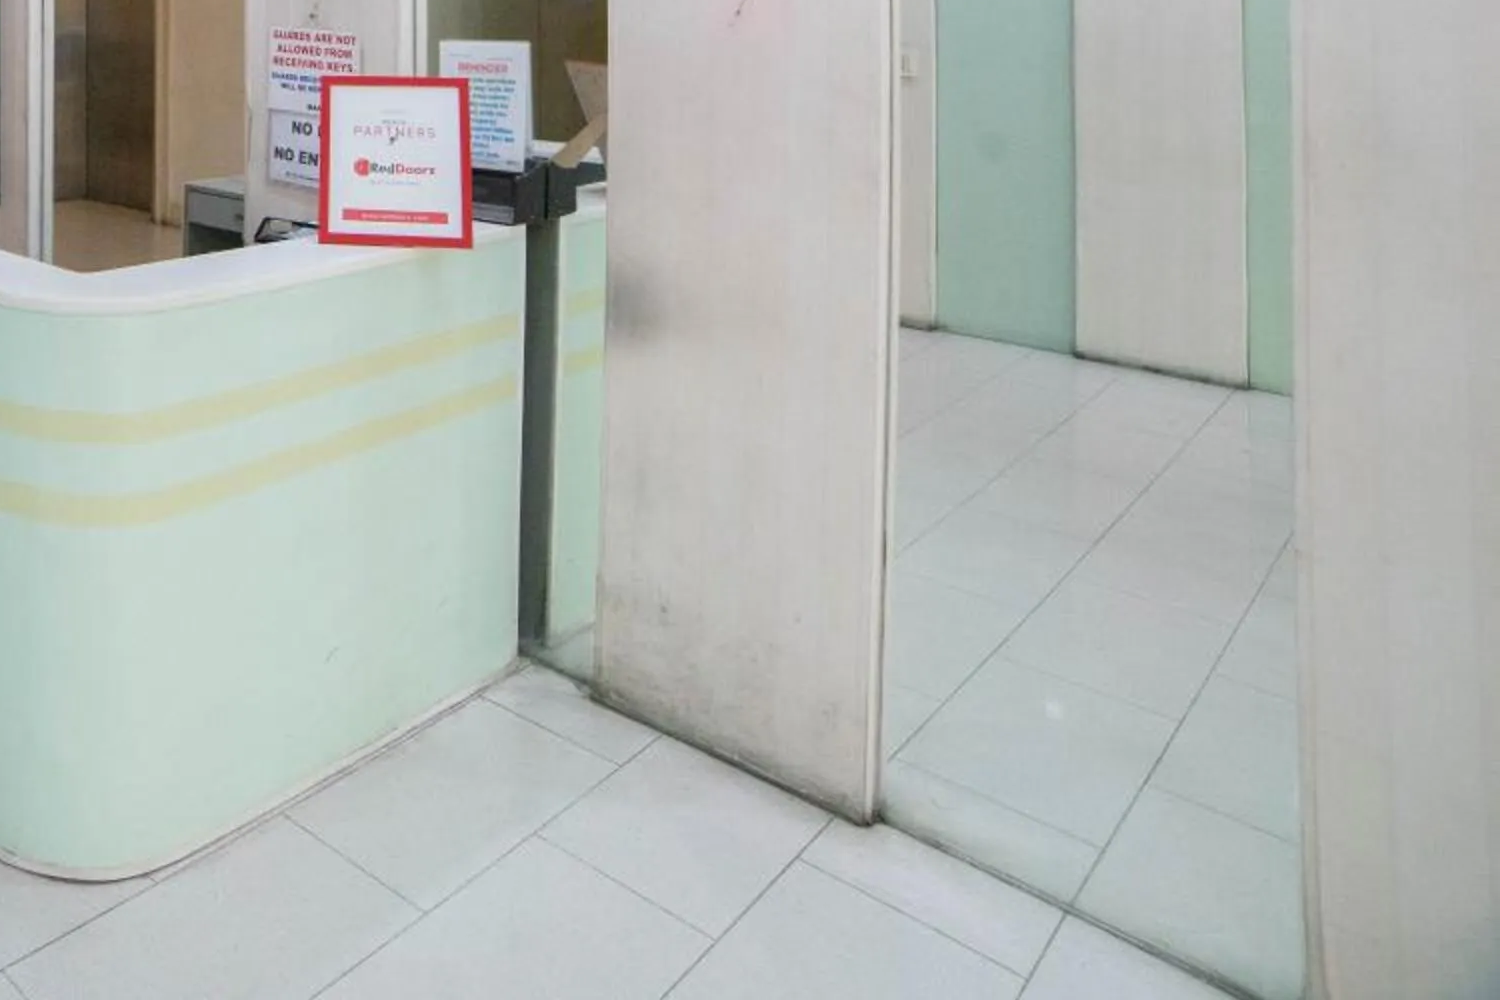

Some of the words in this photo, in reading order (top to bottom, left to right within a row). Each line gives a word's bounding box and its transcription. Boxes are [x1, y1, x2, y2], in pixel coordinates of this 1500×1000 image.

[273, 29, 312, 41] GUARDS
[314, 33, 333, 43] ARE
[335, 35, 357, 46] NOT
[277, 43, 322, 56] ALLOWED
[324, 48, 353, 59] FROM
[273, 56, 325, 71] RECEIVING
[291, 120, 313, 136] NO
[353, 125, 436, 139] PARTNERS
[274, 147, 294, 161] NO
